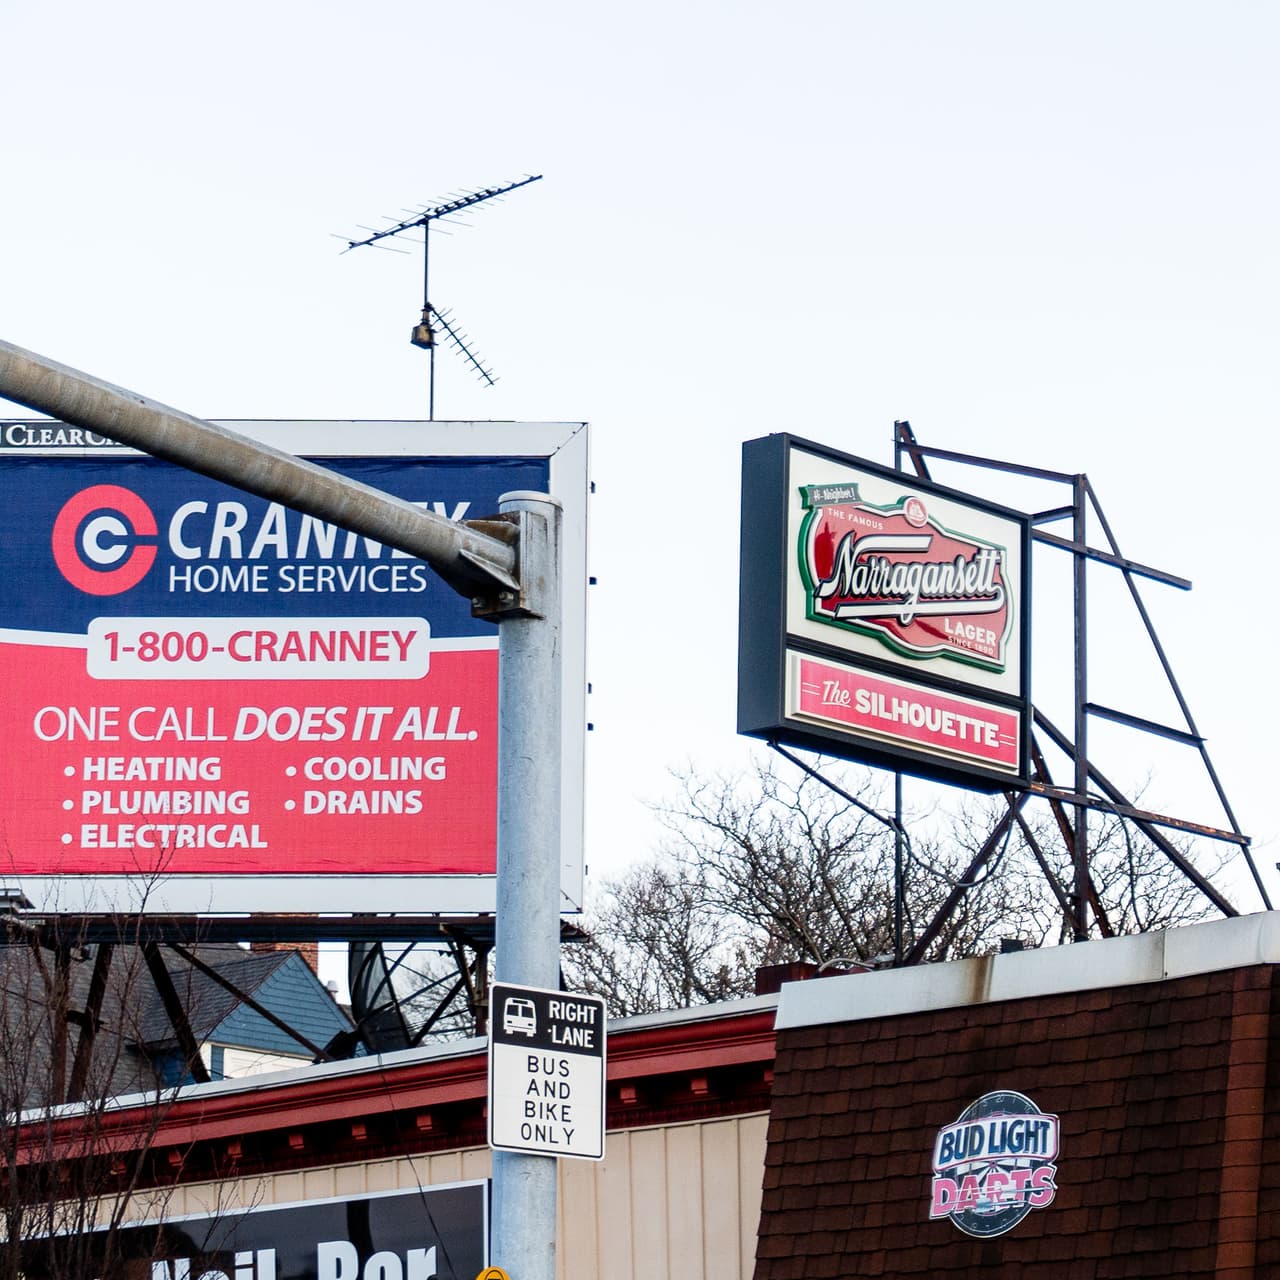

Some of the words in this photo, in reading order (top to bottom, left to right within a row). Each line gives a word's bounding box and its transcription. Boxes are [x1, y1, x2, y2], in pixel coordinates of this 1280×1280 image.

[168, 500, 471, 560] CRAN
[827, 508, 846, 519] THE
[848, 514, 884, 530] FAMOUS
[169, 565, 269, 593] HOME
[278, 564, 428, 593] SERVICES
[814, 530, 1006, 626] Narragansett
[944, 617, 997, 647] LAGER
[103, 629, 418, 663] 1-800-CRANNEY
[33, 706, 120, 742] ONE
[128, 706, 227, 742] CALL
[233, 706, 347, 742] DOES
[351, 706, 393, 741] IT
[392, 706, 478, 742] ALL.
[822, 680, 851, 706] The
[855, 688, 1001, 748] SILHOUETTE
[82, 757, 222, 782] HEATING
[303, 757, 447, 781] COOLING
[80, 790, 250, 815] PLUMBING
[303, 790, 424, 815] DRAINS
[79, 824, 269, 849] ELECTRICAL
[549, 1000, 598, 1025] RIGHT
[551, 1027, 595, 1049] LANE
[527, 1055, 571, 1077] BUS
[526, 1078, 571, 1100] AND
[524, 1100, 572, 1123] BIKE
[520, 1122, 575, 1146] ONLY
[938, 1124, 985, 1166] BUD
[989, 1119, 1051, 1154] LIGHT
[933, 1167, 1055, 1217] DARTS
